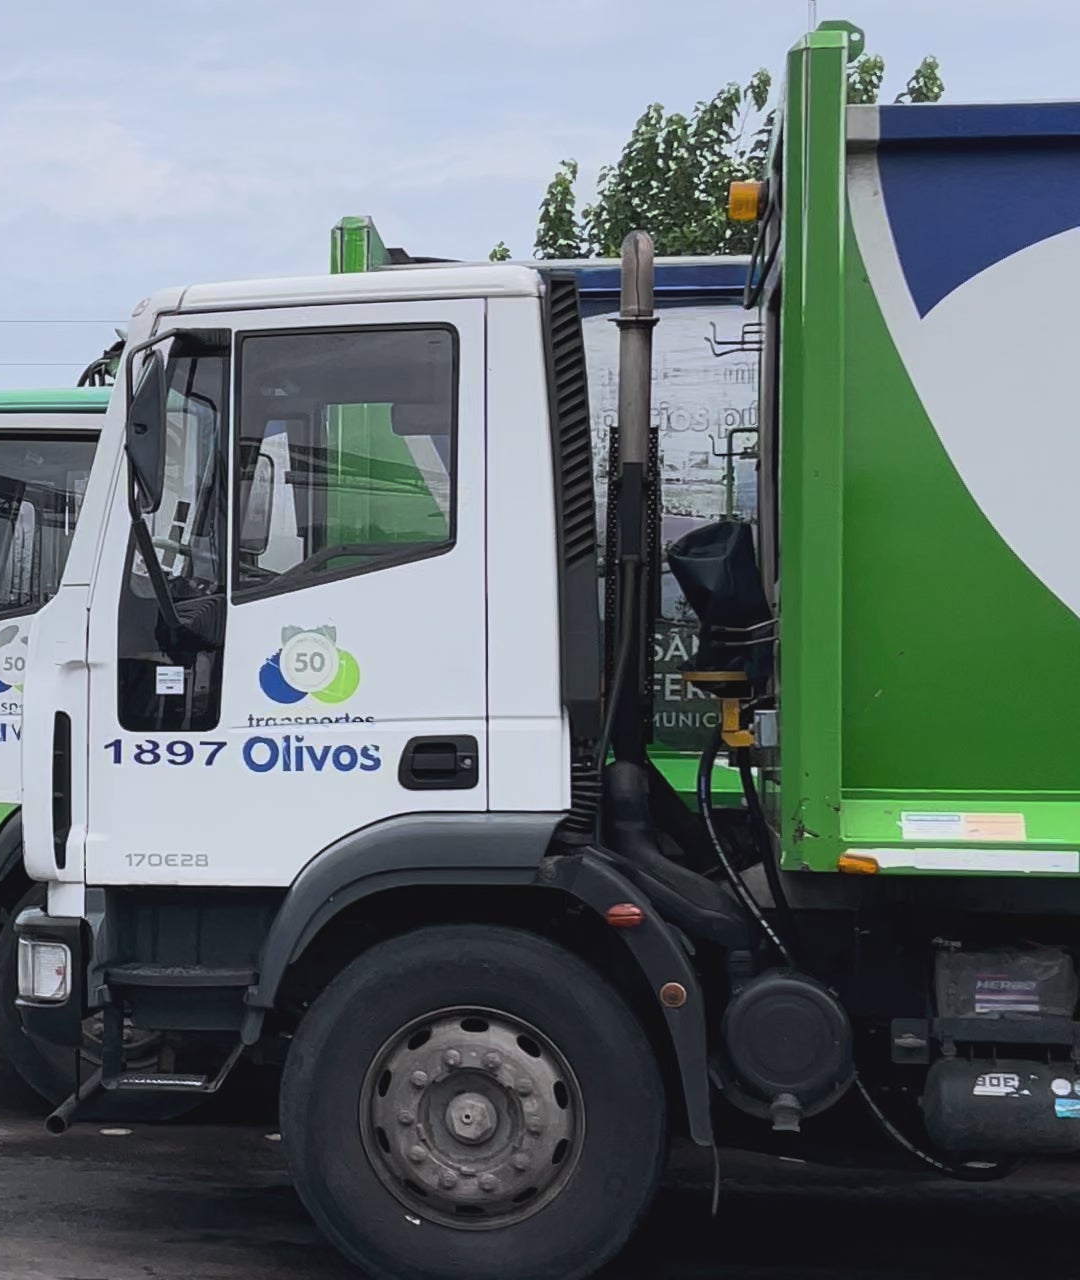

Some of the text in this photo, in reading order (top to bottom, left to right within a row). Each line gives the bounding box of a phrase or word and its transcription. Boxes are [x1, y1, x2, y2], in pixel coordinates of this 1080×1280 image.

[3, 656, 26, 672] 50
[294, 651, 326, 673] 50
[103, 738, 228, 767] 1897
[242, 734, 382, 773] Olivos
[124, 853, 209, 868] 170E28
